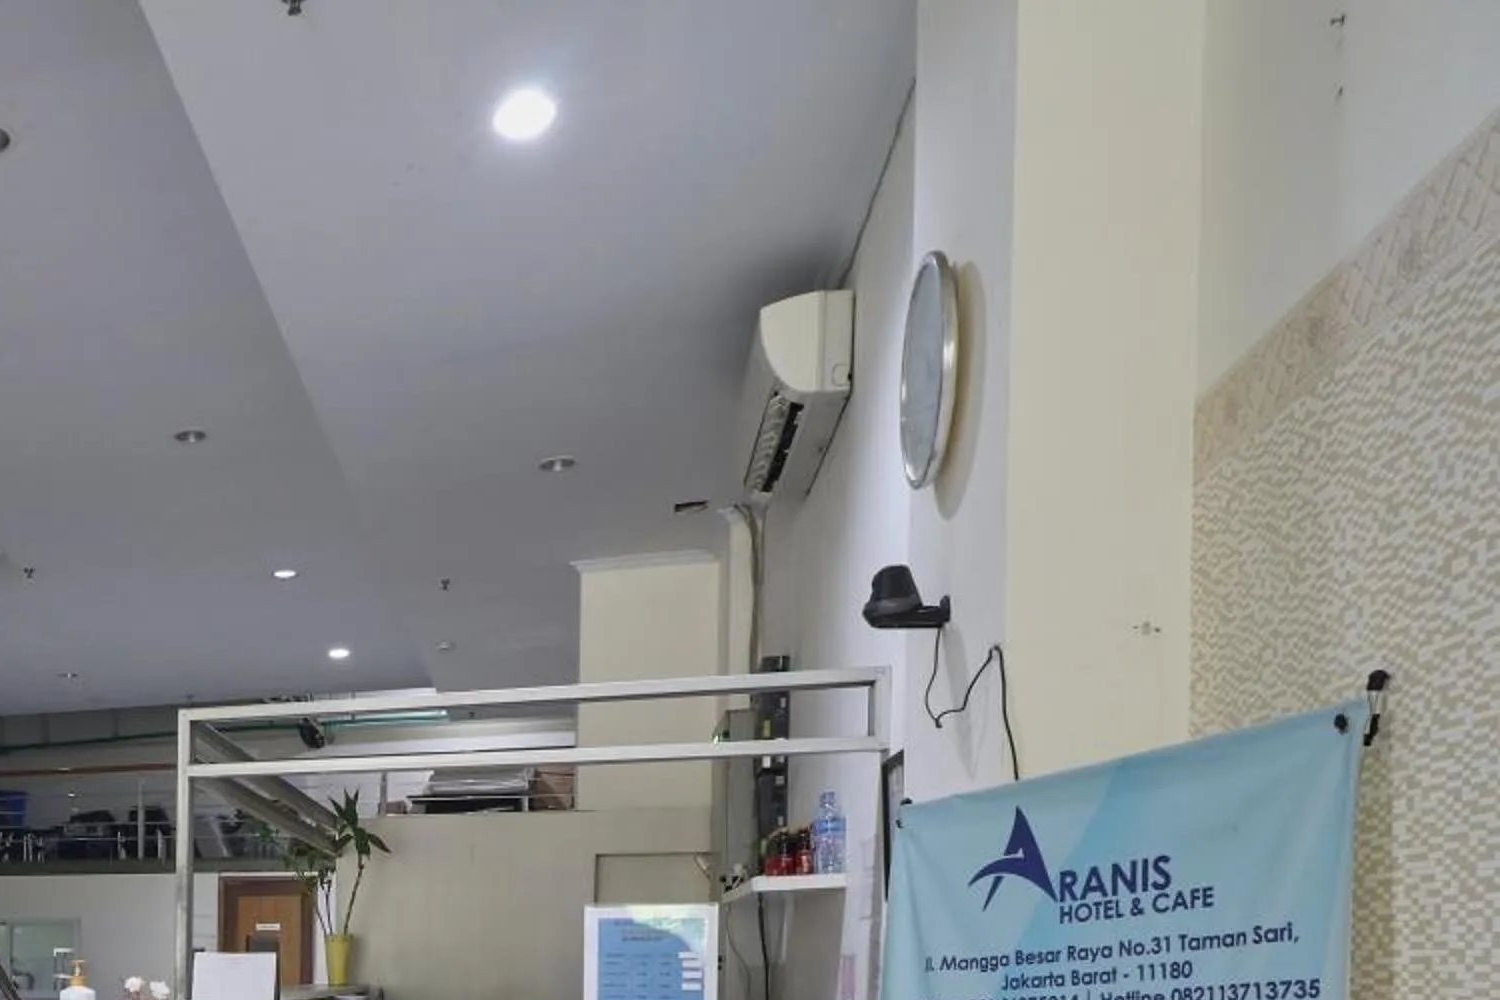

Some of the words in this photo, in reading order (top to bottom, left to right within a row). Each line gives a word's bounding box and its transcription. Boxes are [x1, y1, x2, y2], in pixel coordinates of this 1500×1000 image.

[1059, 898, 1124, 924] HOTEL
[1130, 897, 1145, 916] &
[1152, 886, 1214, 913] CAFE
[940, 954, 1010, 973] Mangga
[1015, 949, 1062, 966] Besar
[1067, 945, 1113, 962] Raya
[1119, 936, 1171, 957] No.31
[1178, 932, 1247, 952] Taman
[1252, 922, 1299, 945] Sari,
[1002, 973, 1066, 990] Jakarta
[1071, 967, 1117, 986] Barat
[1137, 960, 1193, 981] 11180
